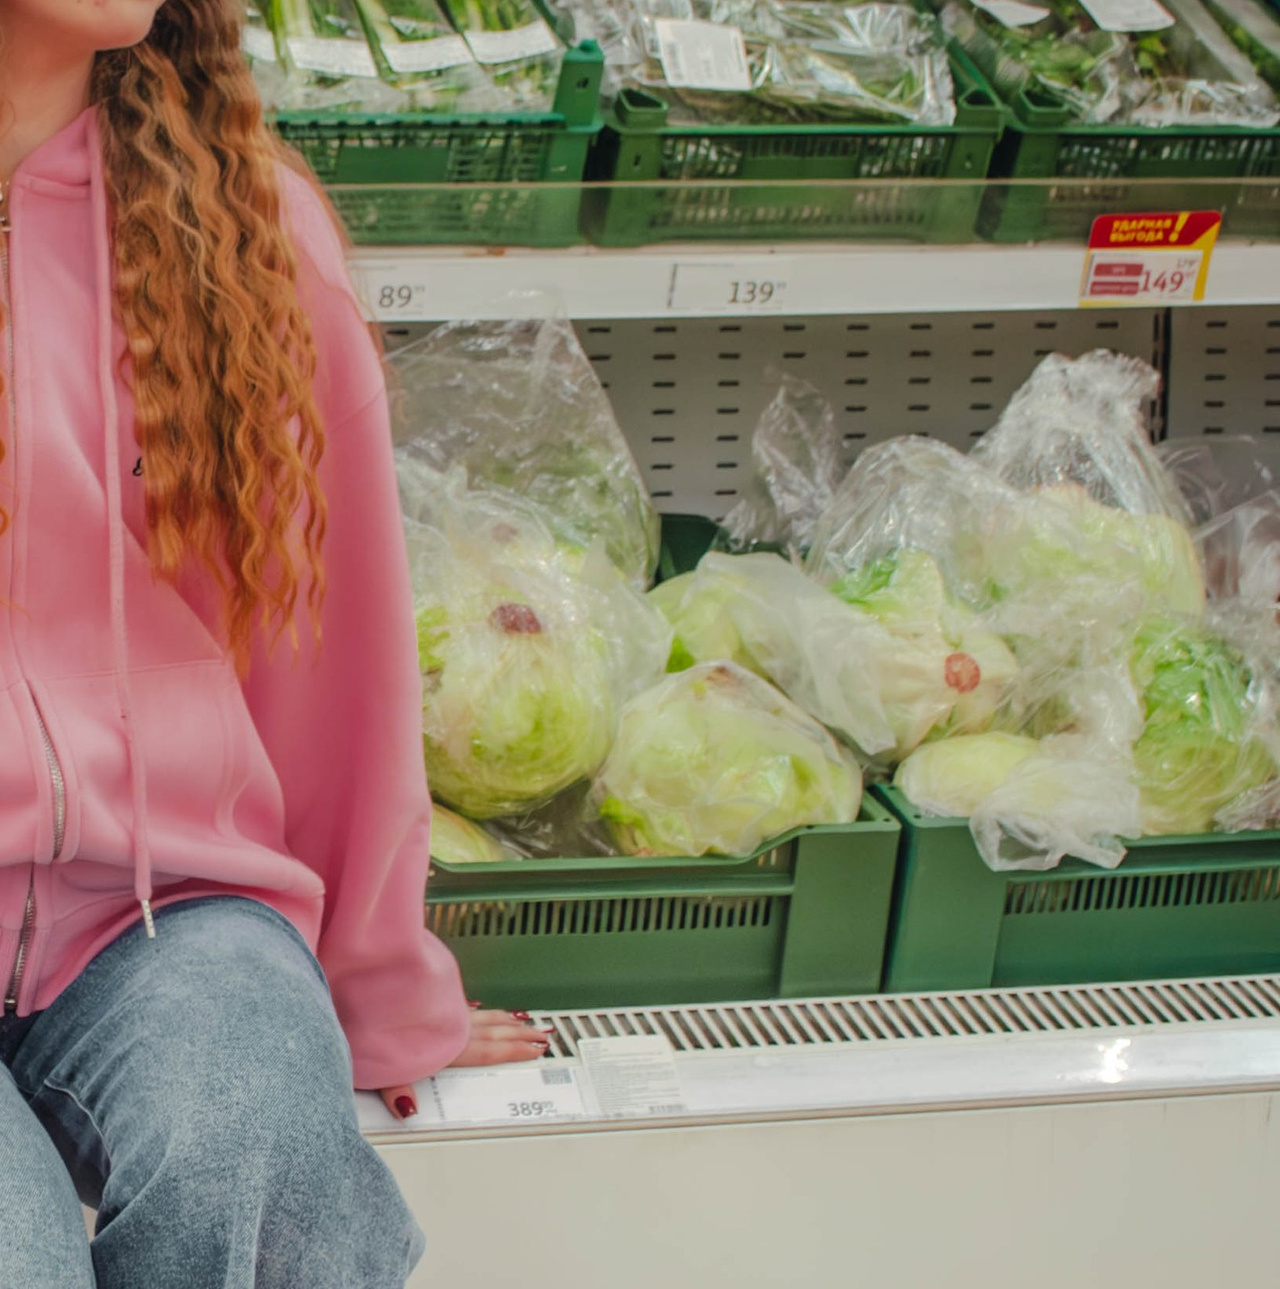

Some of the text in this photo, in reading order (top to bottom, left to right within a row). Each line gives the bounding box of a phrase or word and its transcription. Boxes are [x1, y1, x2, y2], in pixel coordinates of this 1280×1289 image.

[1112, 218, 1172, 232] УДАРНАЯ
[1109, 231, 1165, 243] ВЫГОДА
[1140, 269, 1185, 293] 149
[727, 280, 775, 304] 139
